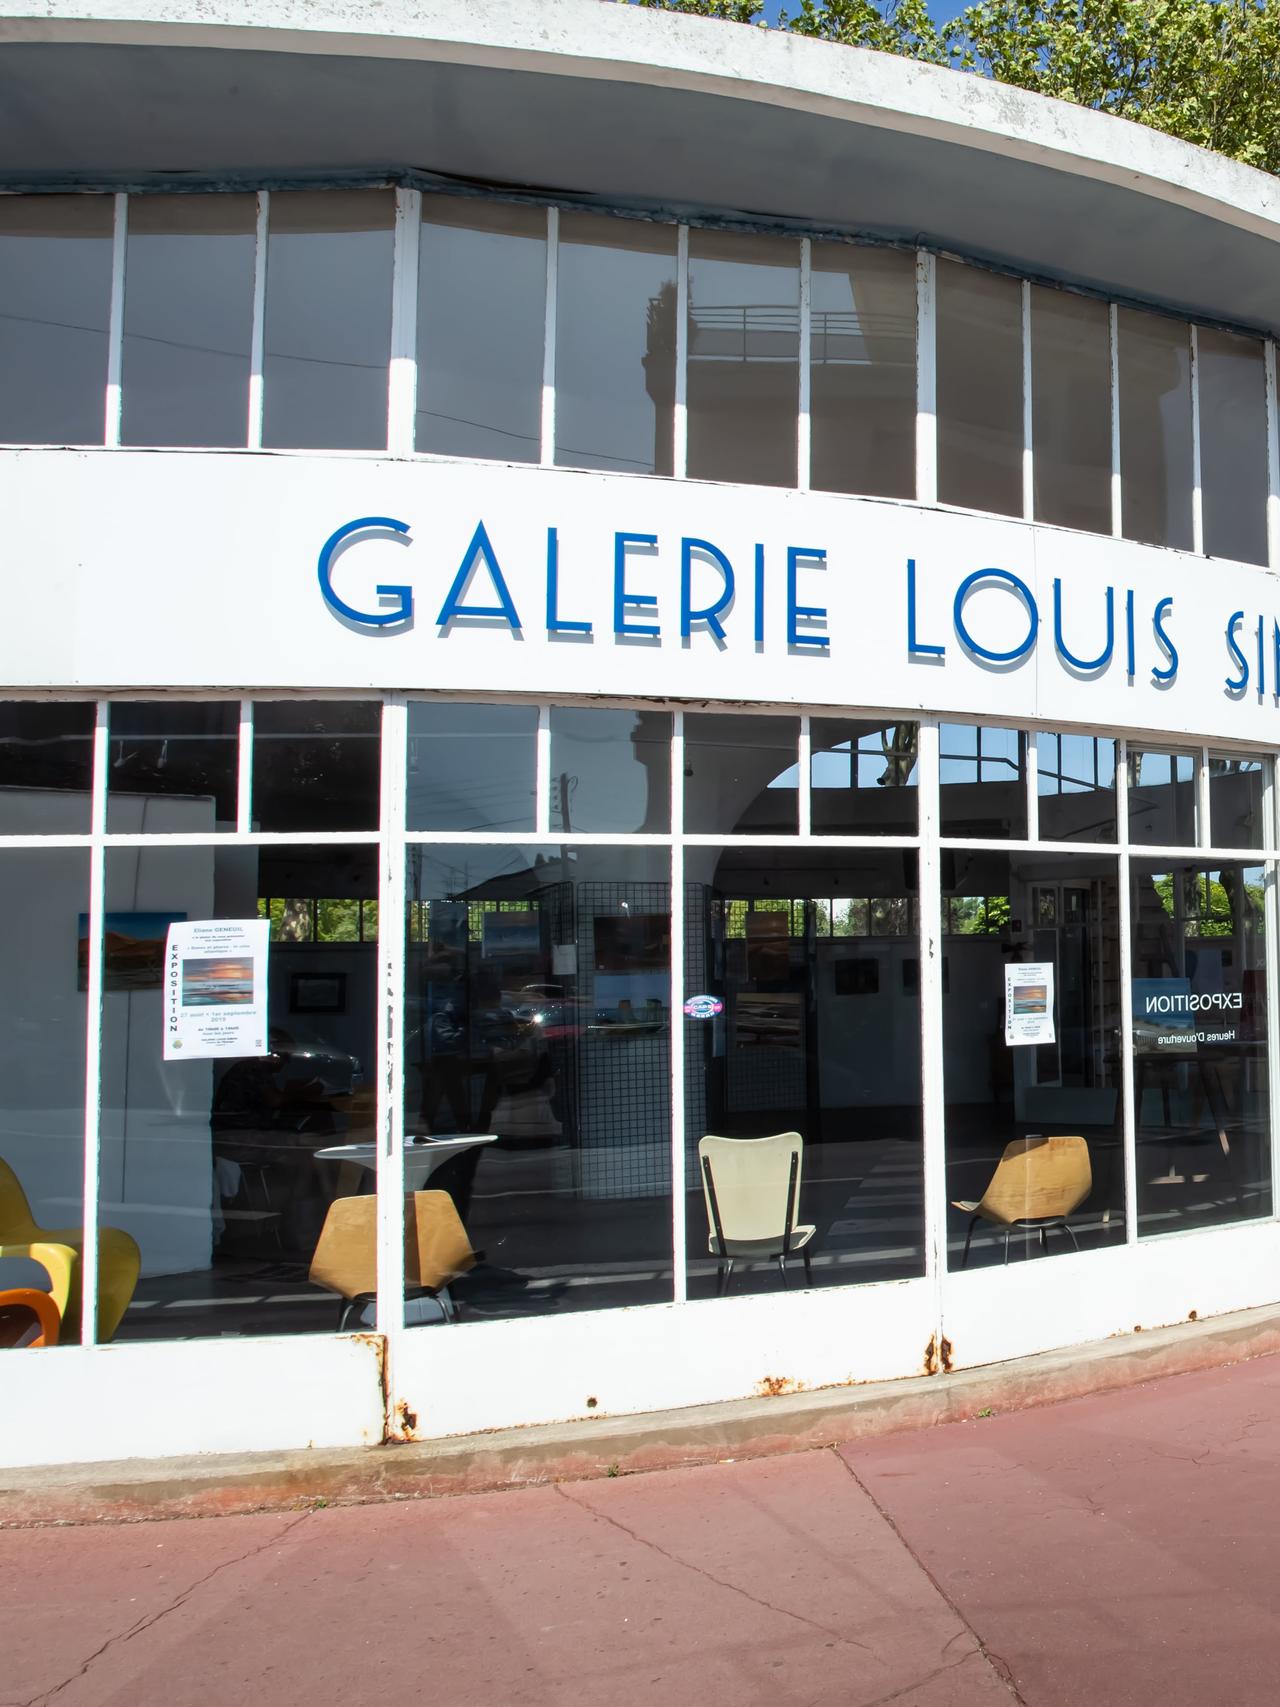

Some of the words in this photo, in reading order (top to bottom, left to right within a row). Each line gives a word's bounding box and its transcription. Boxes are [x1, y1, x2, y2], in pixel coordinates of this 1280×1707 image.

[318, 517, 830, 645] GALERIE
[907, 559, 1179, 680] LOUIS
[170, 945, 178, 1032] EXPOSITION
